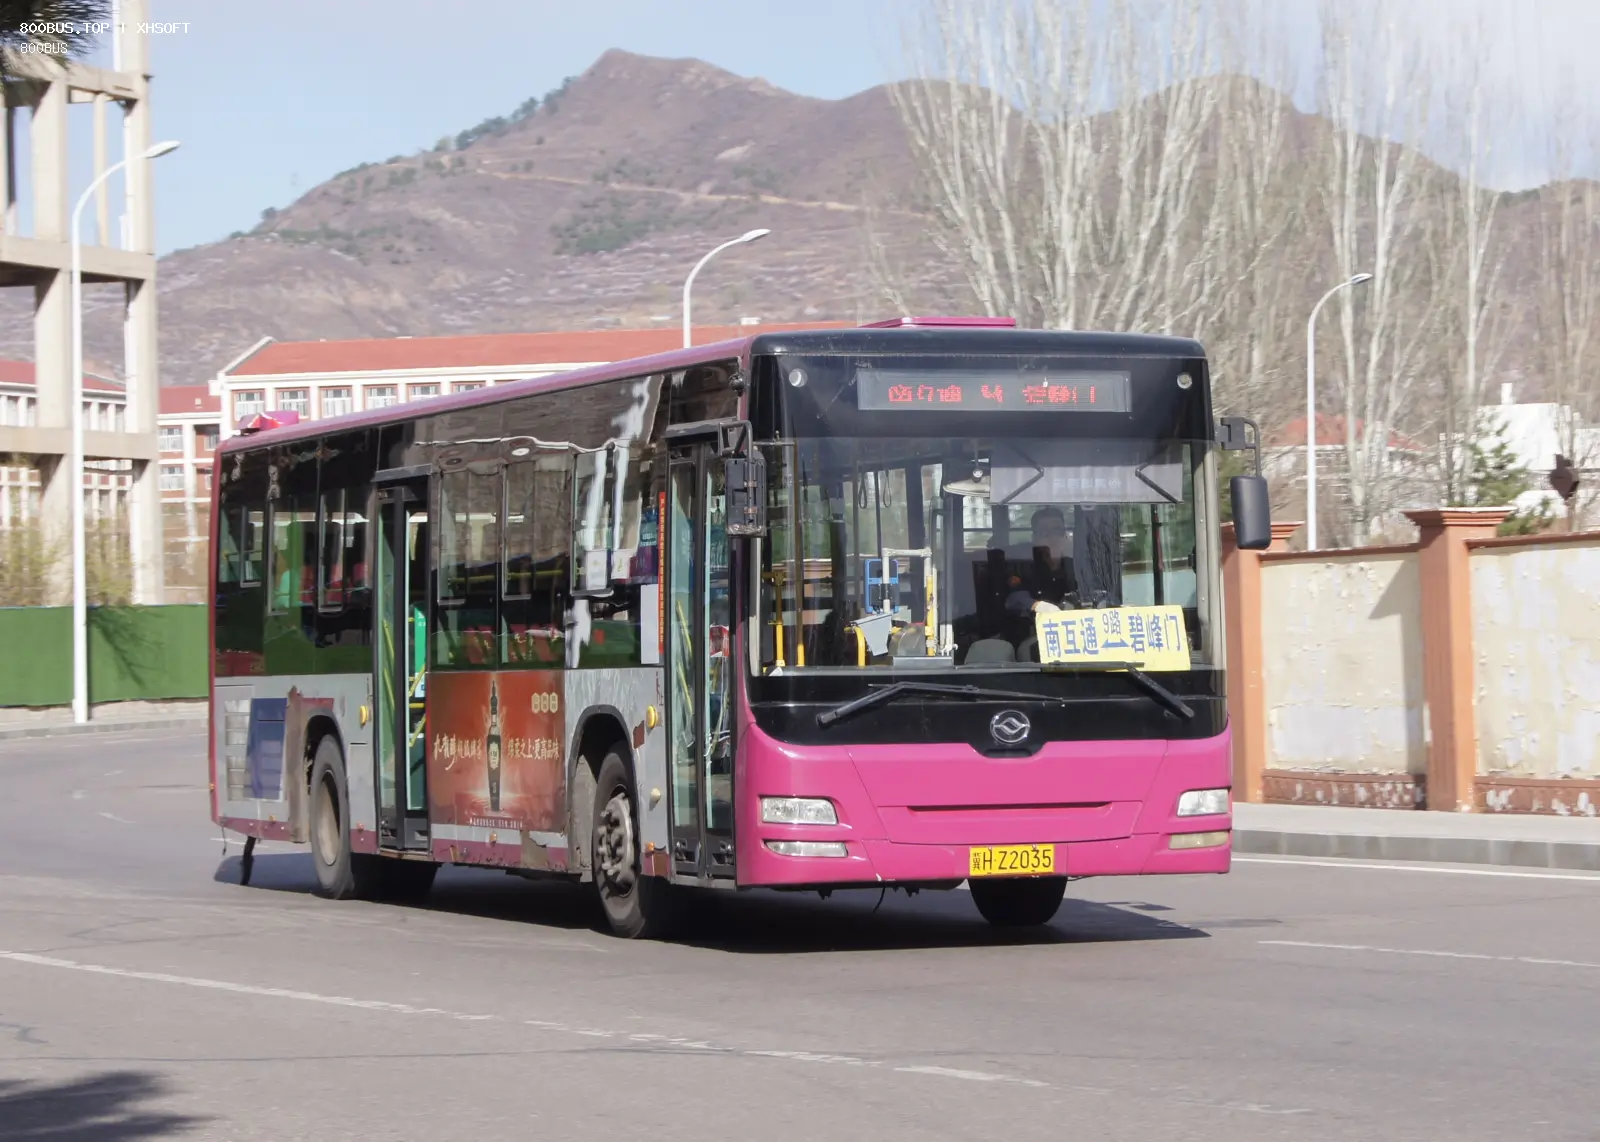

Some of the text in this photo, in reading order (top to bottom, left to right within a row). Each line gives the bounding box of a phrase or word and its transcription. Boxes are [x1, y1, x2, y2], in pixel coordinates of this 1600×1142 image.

[1042, 609, 1181, 658] 南互通 9路 碧峰门
